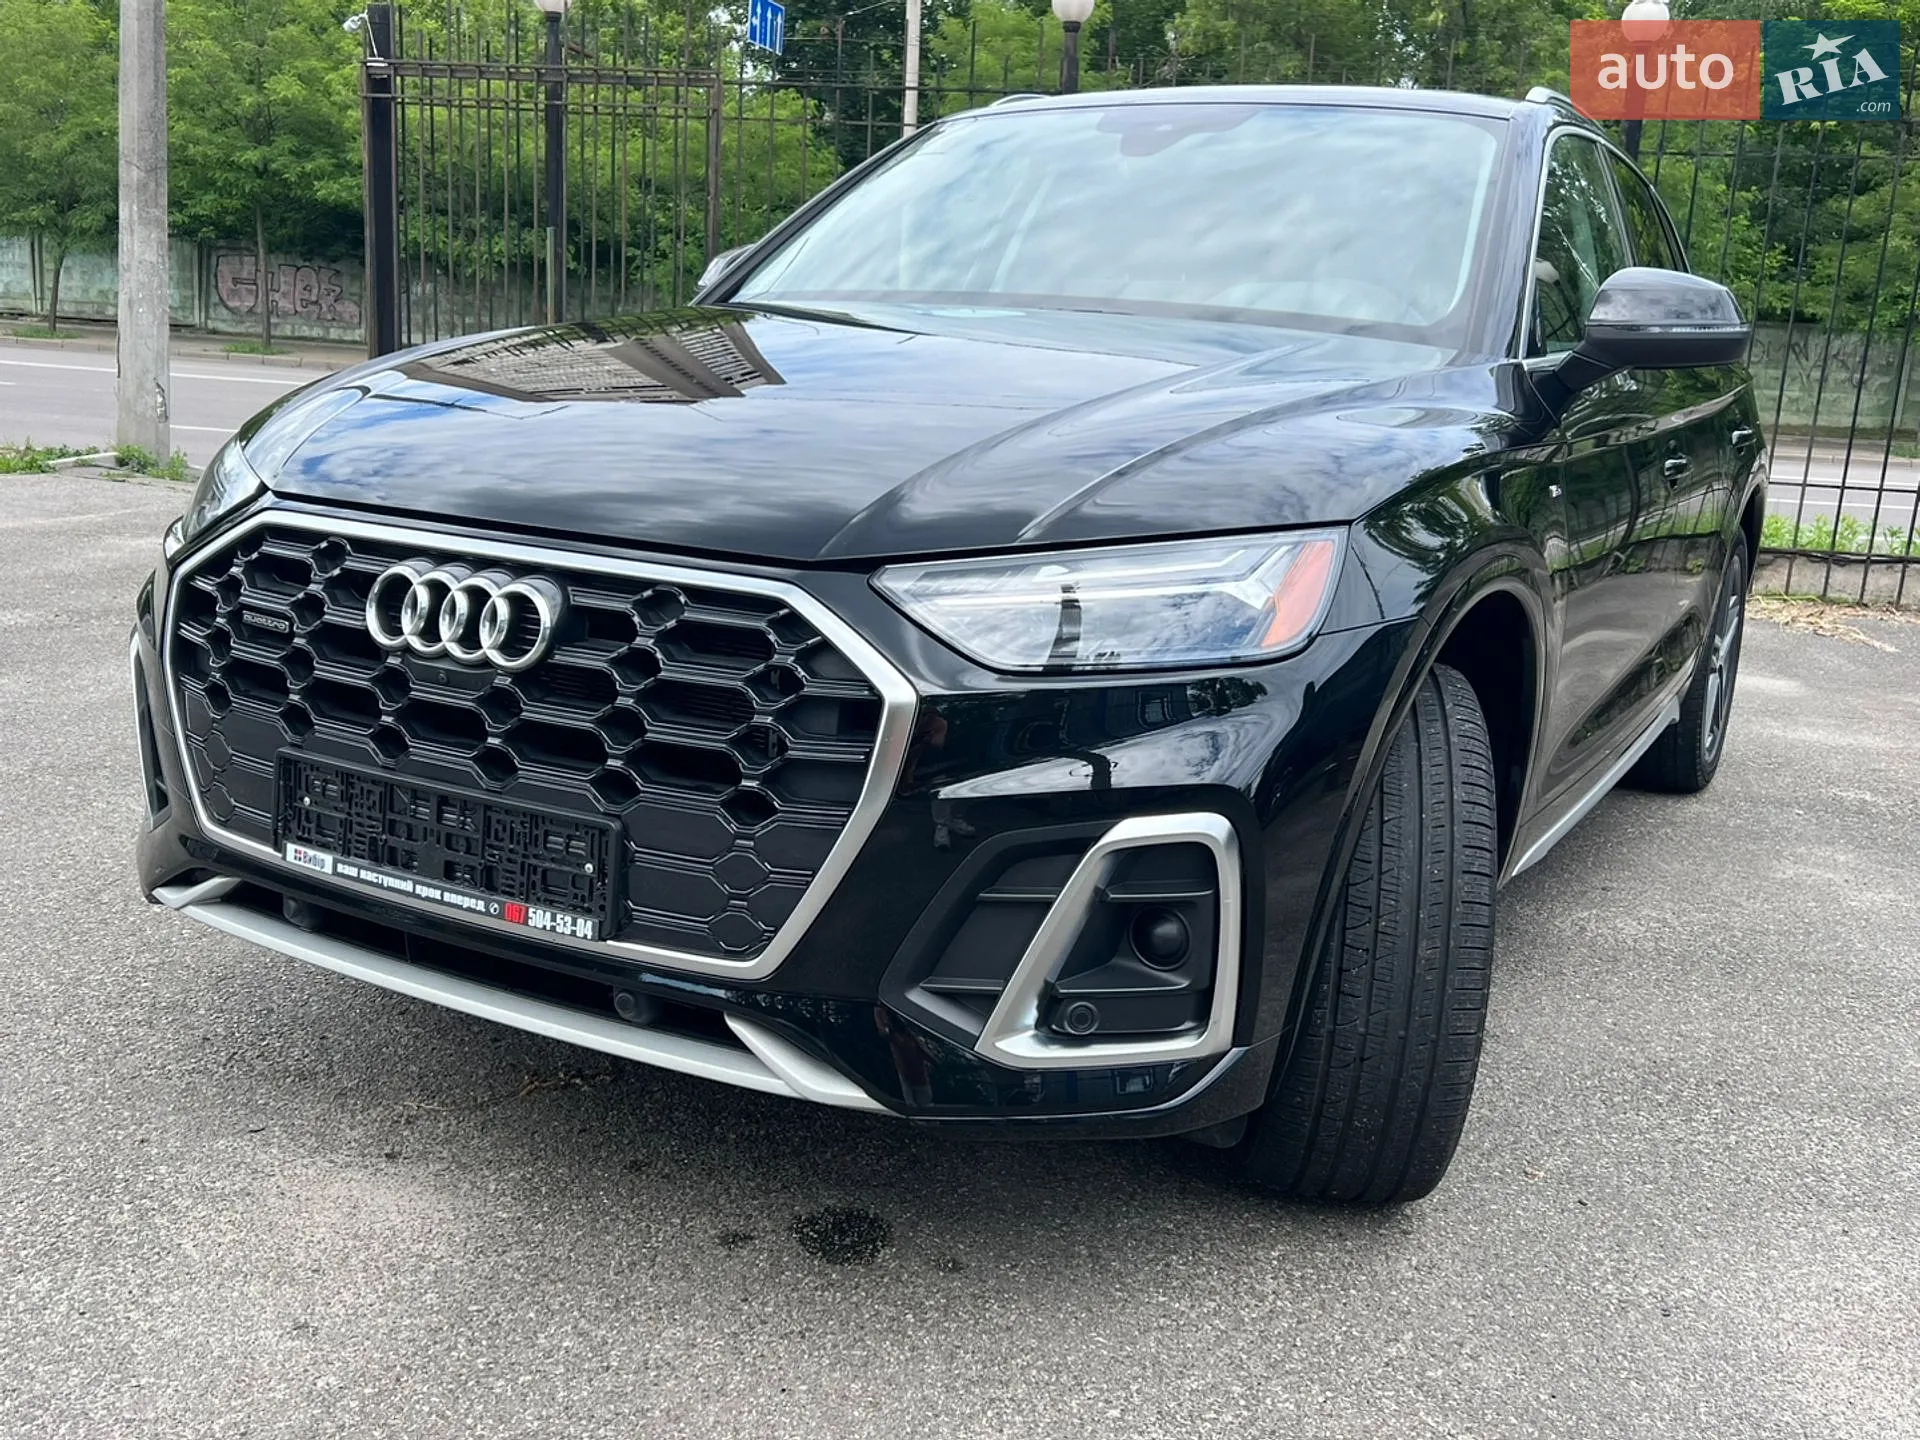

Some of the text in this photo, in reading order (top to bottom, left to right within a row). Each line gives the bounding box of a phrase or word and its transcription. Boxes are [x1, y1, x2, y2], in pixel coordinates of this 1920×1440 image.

[337, 863, 486, 912] ваш наступний крок вперед
[505, 902, 593, 940] 067 504-53-04
